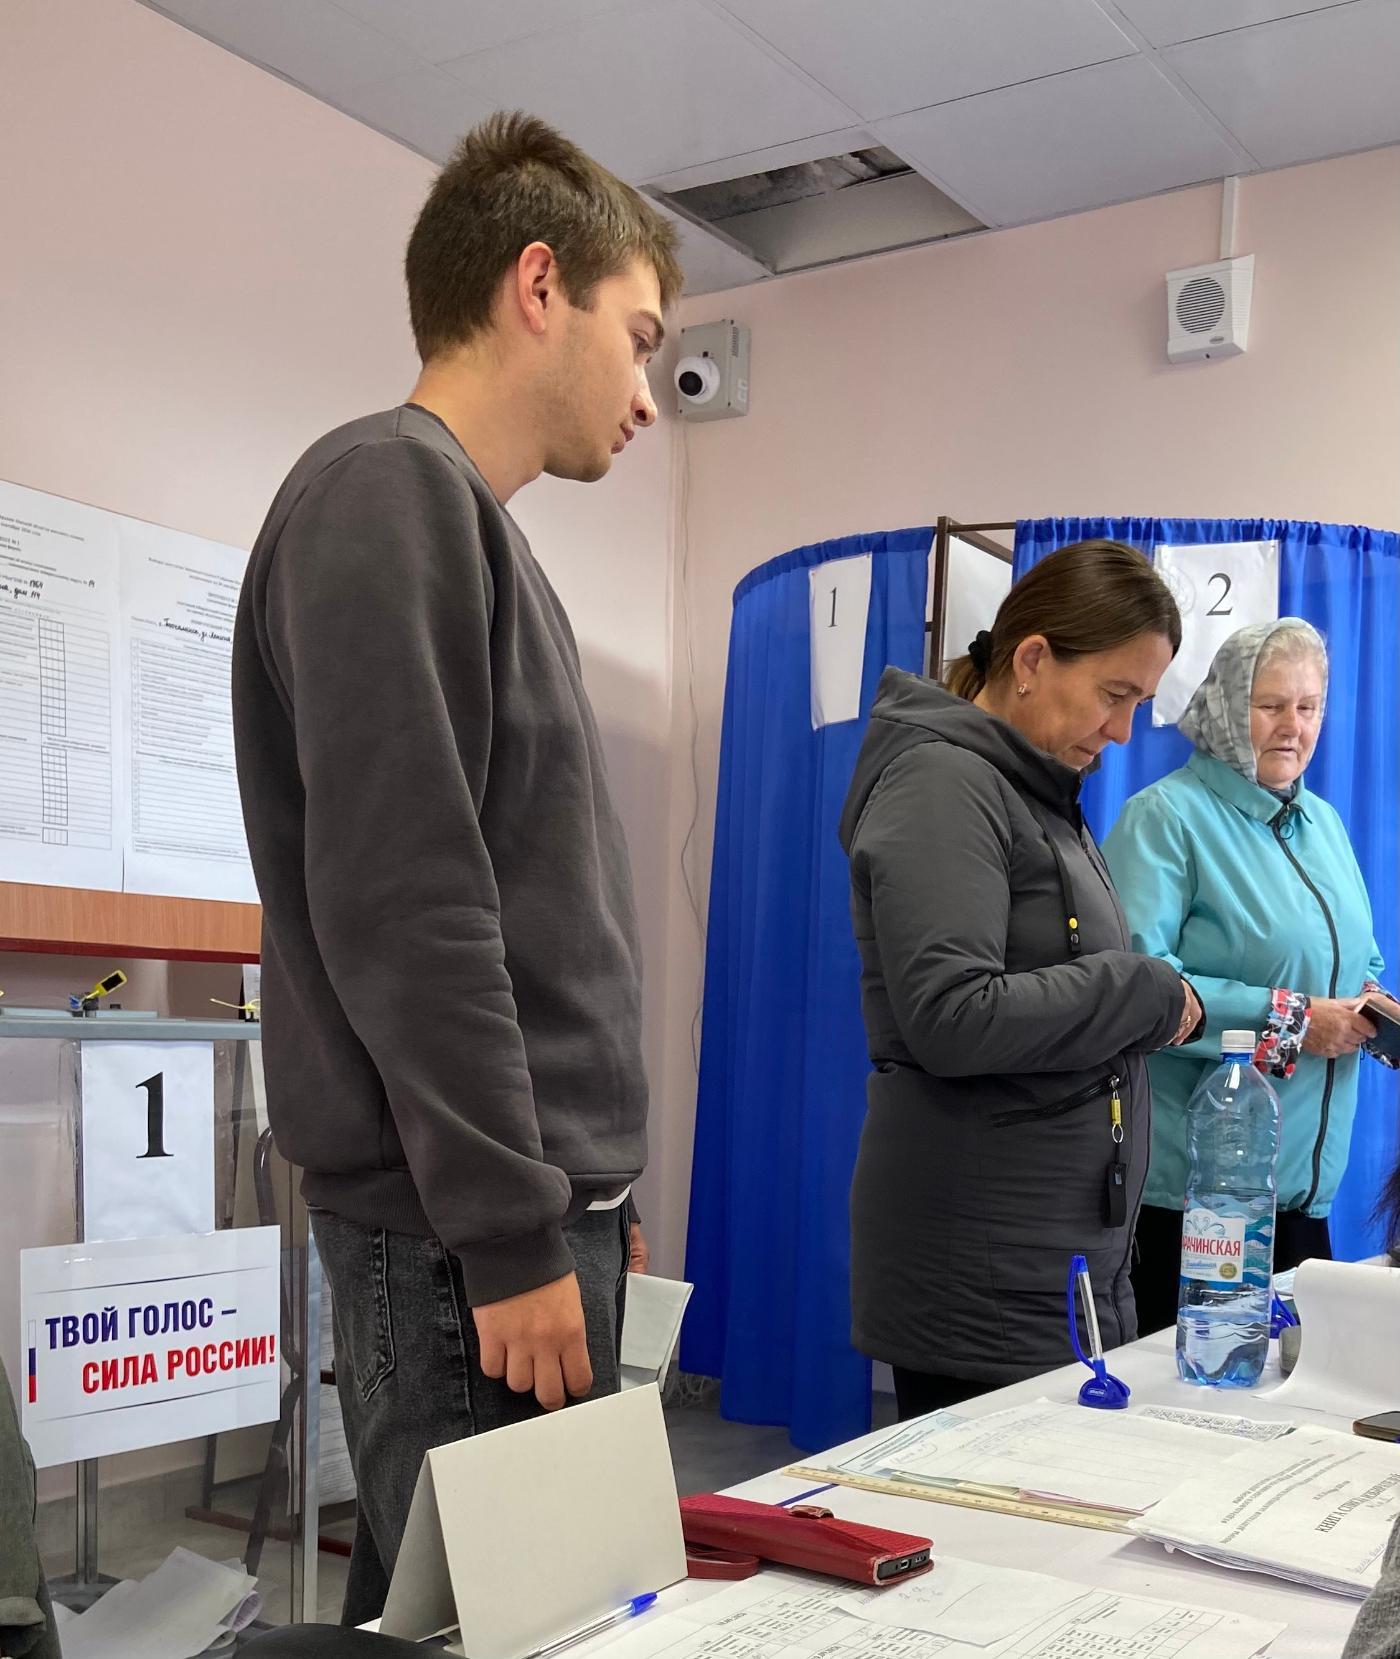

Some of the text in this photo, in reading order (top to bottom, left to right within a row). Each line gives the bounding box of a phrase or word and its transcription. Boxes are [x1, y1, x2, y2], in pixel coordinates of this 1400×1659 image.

[826, 587, 839, 628] 1
[1206, 572, 1233, 616] 2
[135, 1072, 174, 1158] 1
[45, 1305, 118, 1350] ТВОЙ
[128, 1298, 214, 1339] ГОЛОС
[82, 1334, 276, 1394] СИЛА РОССИИ!
